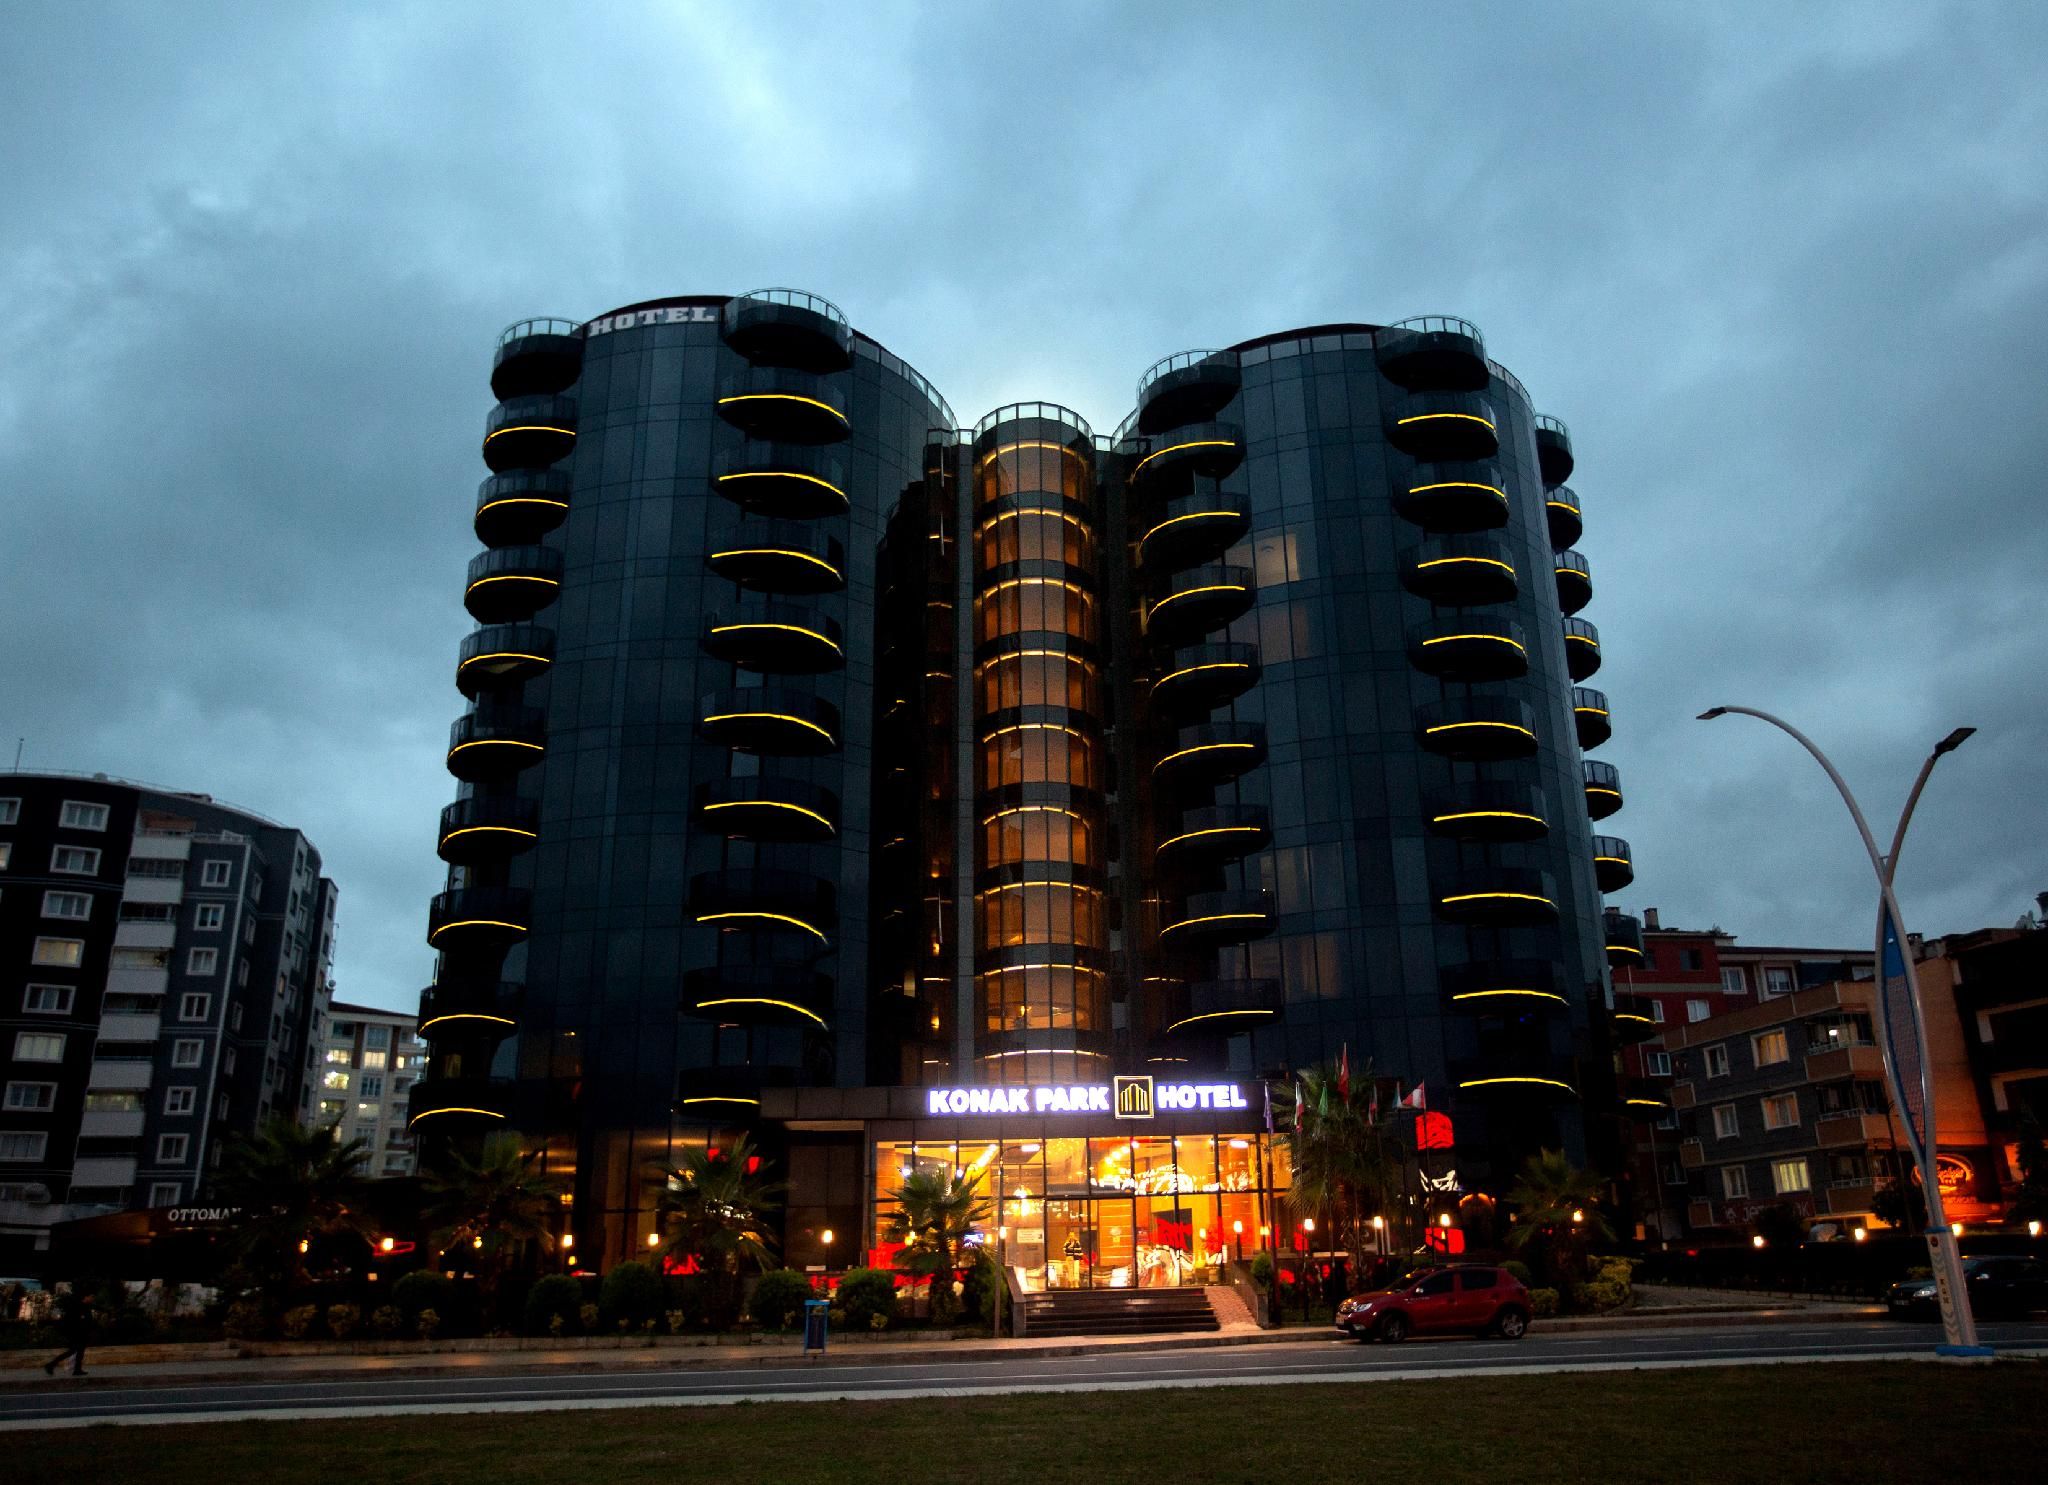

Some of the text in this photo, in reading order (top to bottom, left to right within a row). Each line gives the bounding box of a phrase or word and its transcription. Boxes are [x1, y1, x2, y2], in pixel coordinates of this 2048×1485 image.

[588, 306, 715, 337] HOTEL
[929, 1085, 1247, 1113] KONAK PARK HOTEL
